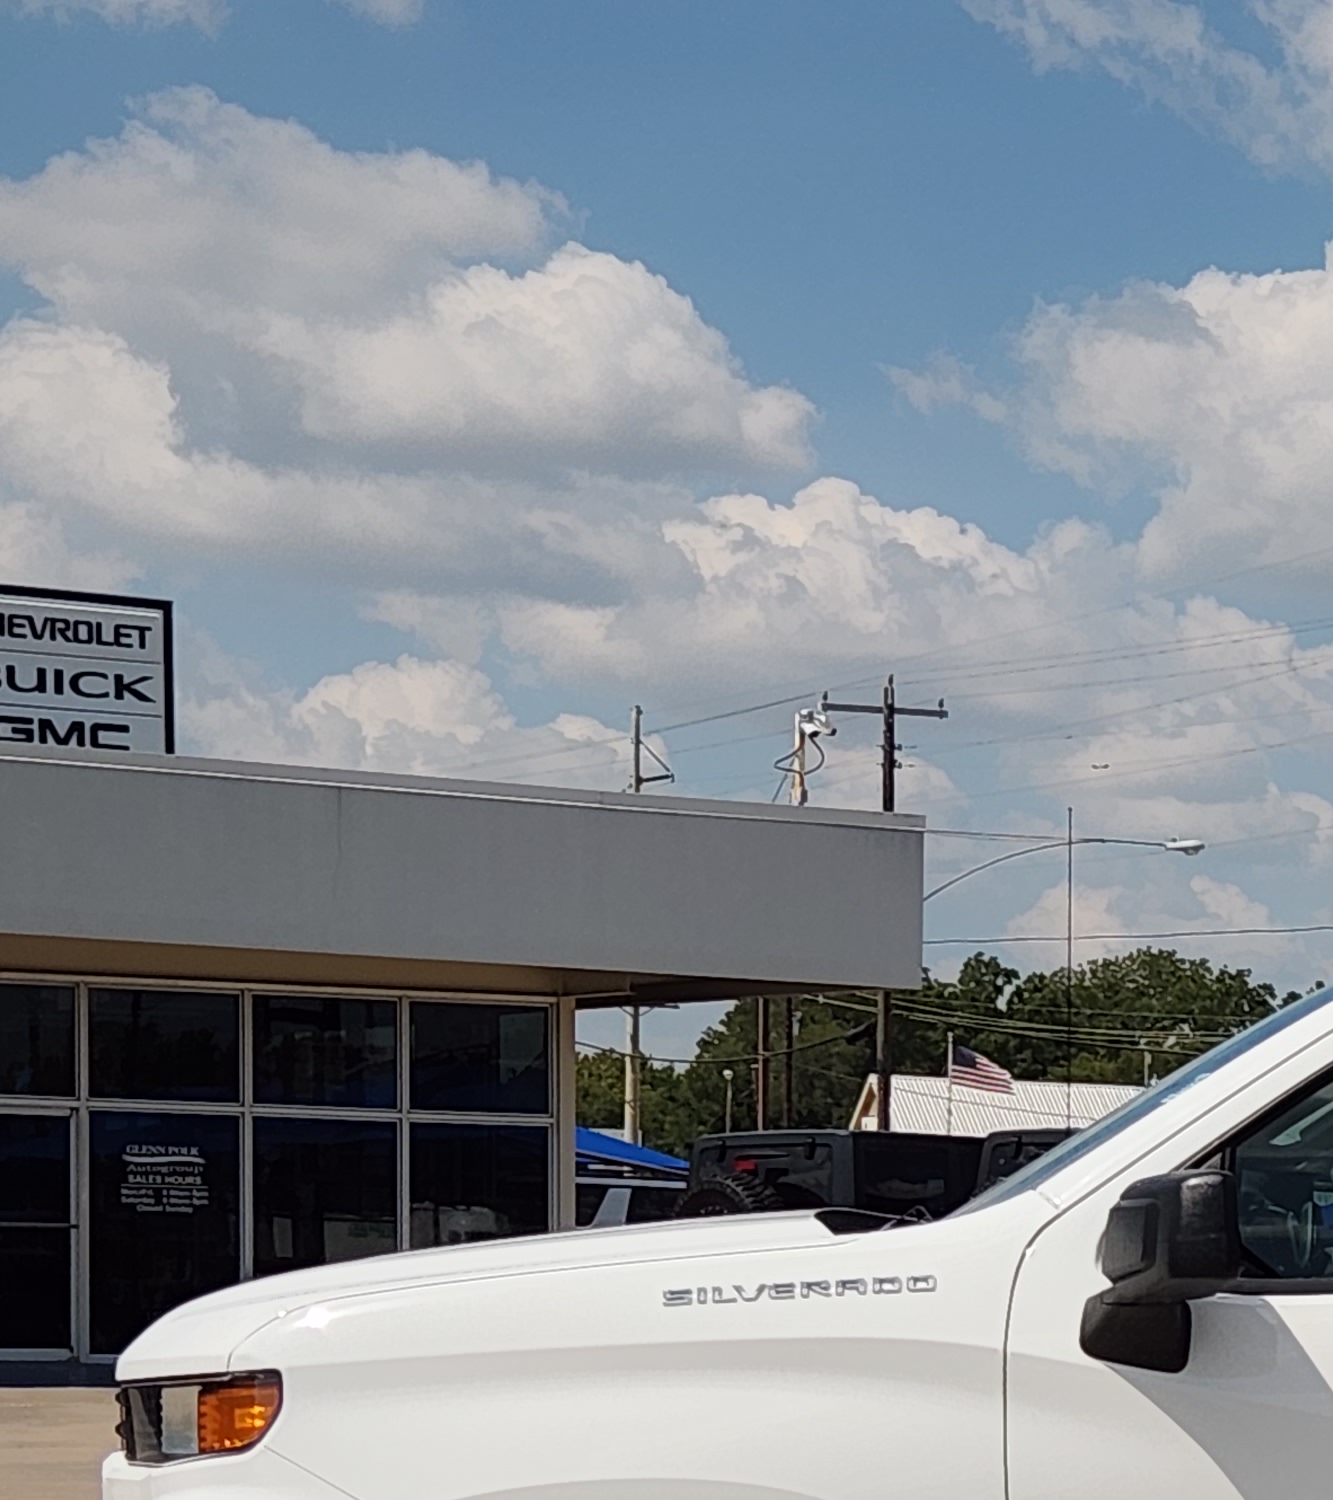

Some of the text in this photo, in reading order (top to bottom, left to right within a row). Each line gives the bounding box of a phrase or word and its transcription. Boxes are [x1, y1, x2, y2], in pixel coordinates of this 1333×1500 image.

[0, 612, 153, 650] EVROLET
[0, 664, 157, 704] UICK
[0, 715, 131, 752] GMC
[126, 1144, 166, 1155] GLENN
[127, 1174, 203, 1186] SALES HOURS
[662, 1274, 938, 1307] SILVERADO
